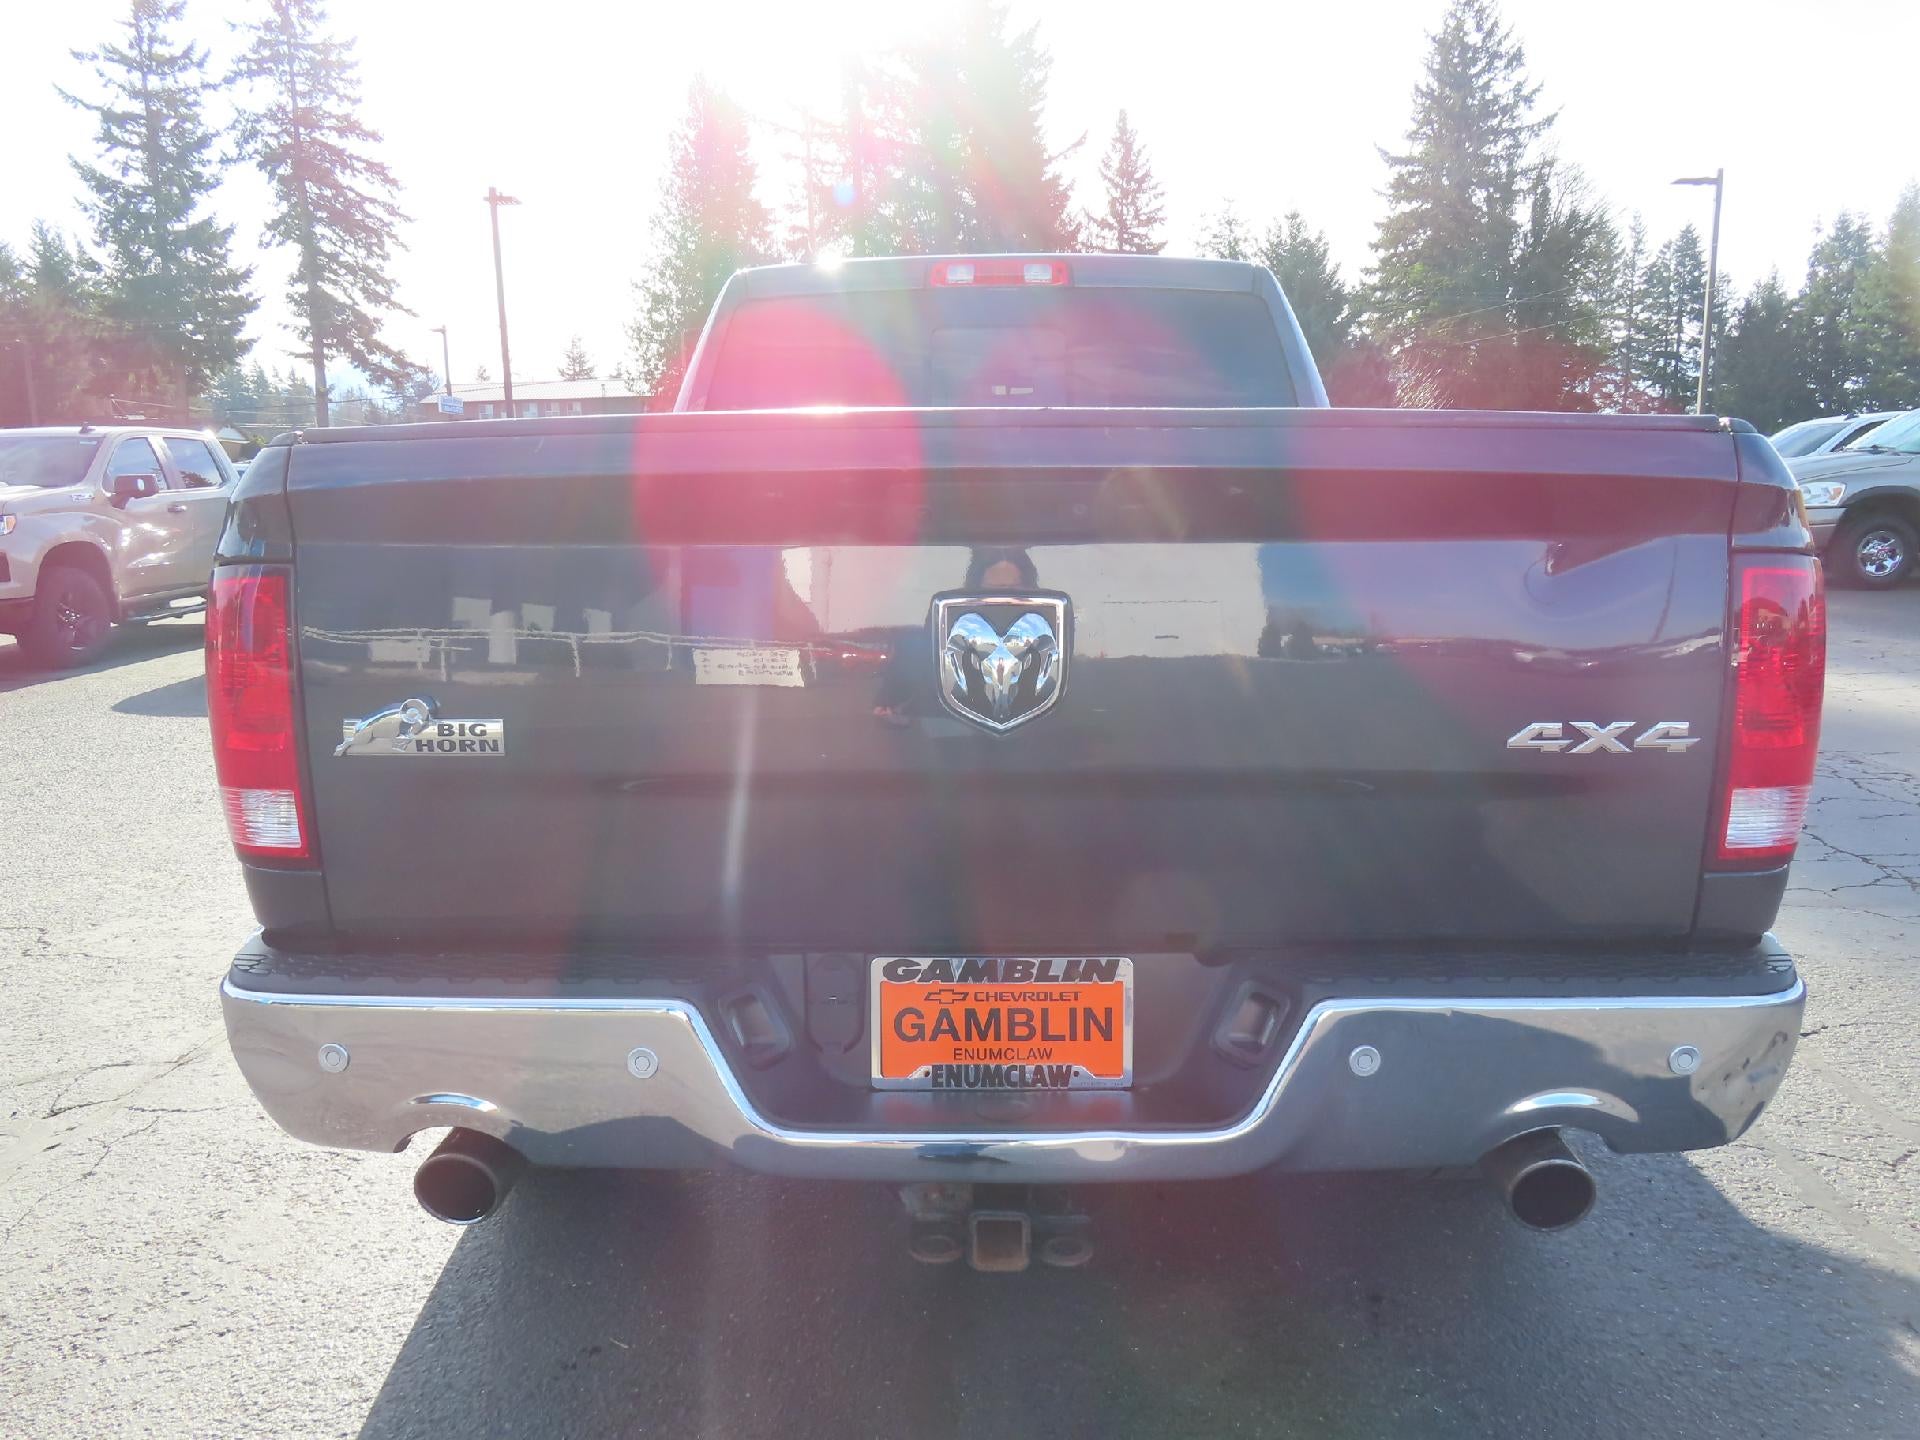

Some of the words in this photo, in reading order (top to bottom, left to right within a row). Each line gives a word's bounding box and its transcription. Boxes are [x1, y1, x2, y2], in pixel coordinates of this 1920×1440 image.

[437, 723, 487, 737] BIG
[1507, 721, 1701, 753] 4X4
[415, 739, 499, 752] HORN
[882, 958, 1120, 983] GAMBLIN
[973, 991, 1082, 1002] CHEVROLET
[893, 1007, 1113, 1042] GAMBLIN
[953, 1048, 1053, 1061] ENUMCLAW
[931, 1064, 1073, 1088] ENUMCLAW
